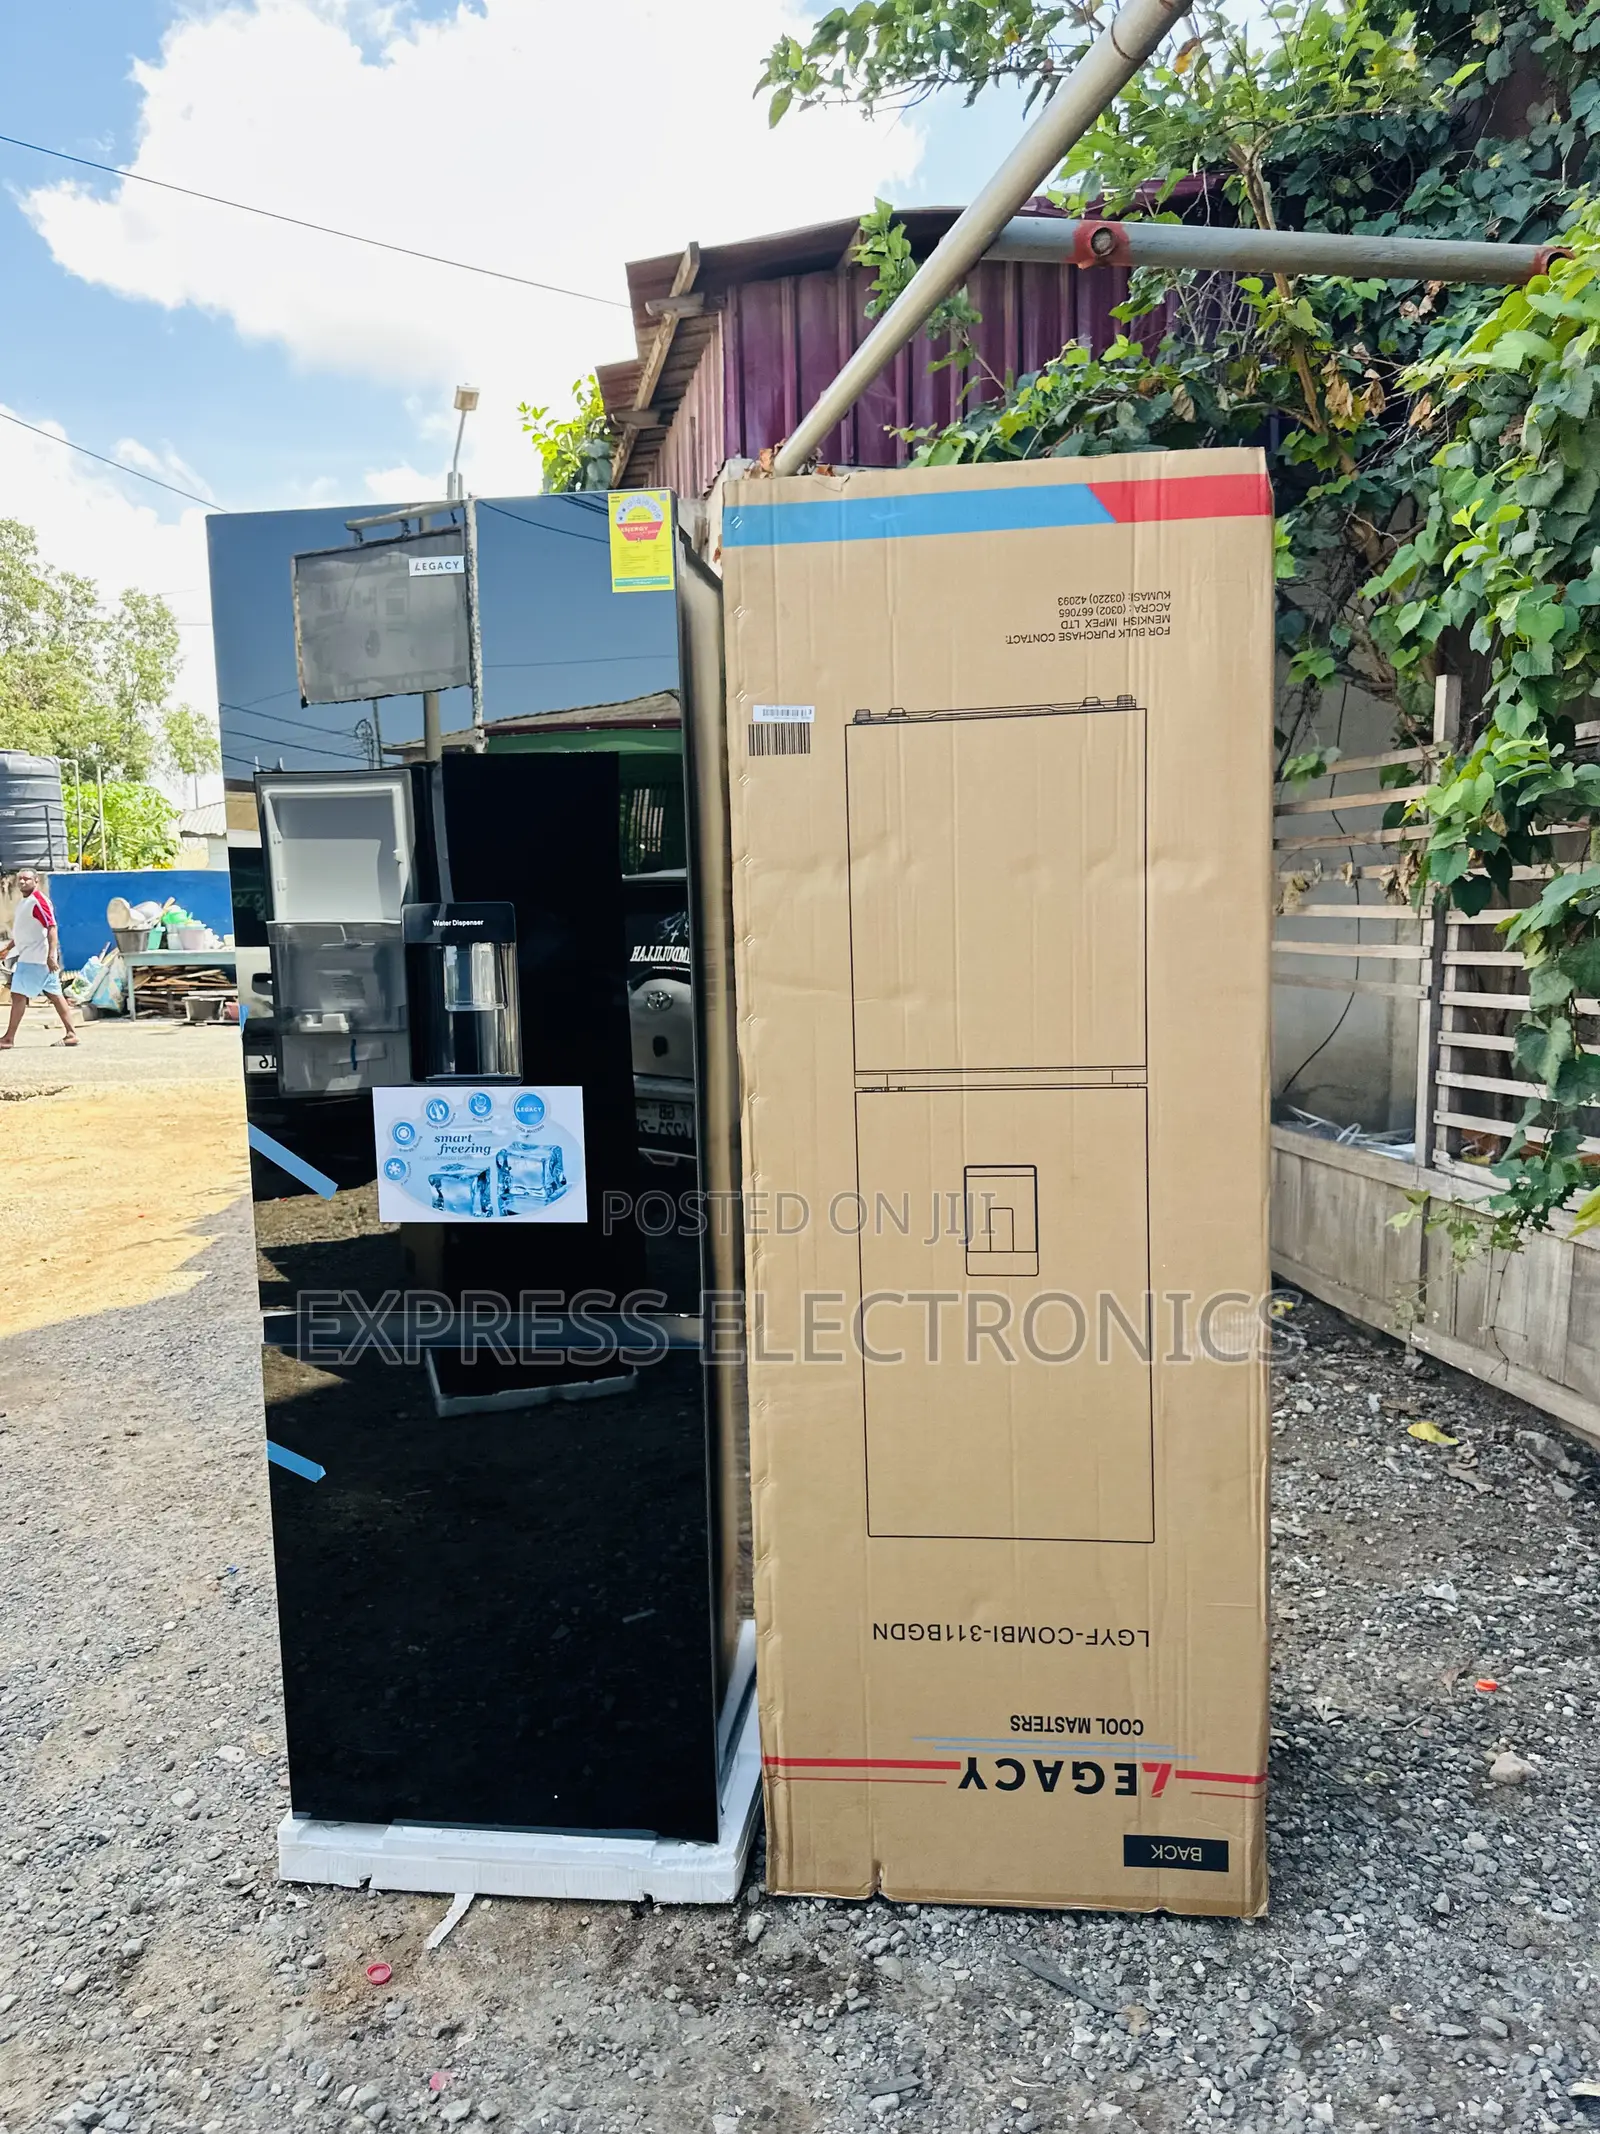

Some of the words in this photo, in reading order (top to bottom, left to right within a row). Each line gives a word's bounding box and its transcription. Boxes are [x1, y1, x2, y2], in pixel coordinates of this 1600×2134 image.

[414, 560, 459, 571] LEGACY
[1057, 595, 1087, 606] 42093
[1089, 591, 1125, 605] (03220)
[1127, 590, 1171, 601] KUMASI:
[1058, 606, 1094, 618] 667065
[1095, 604, 1126, 616] (0302)
[1060, 619, 1080, 630] LTD
[1084, 617, 1117, 628] IMPEX
[1123, 614, 1171, 625] MENKISH
[1058, 629, 1116, 642] PURCHASE
[1118, 627, 1146, 638] BULK
[1148, 626, 1171, 636] FOR
[1005, 632, 1056, 645] CONTACT:
[434, 1134, 473, 1143] smart
[437, 1143, 491, 1156] freezing
[872, 1622, 1150, 1648] LGYF-COMBI-311BGDN
[1010, 1714, 1091, 1734] MASTERS
[1096, 1717, 1144, 1736] COOL
[958, 1756, 1172, 1799] LEGACY
[1151, 1843, 1203, 1862] BACK
